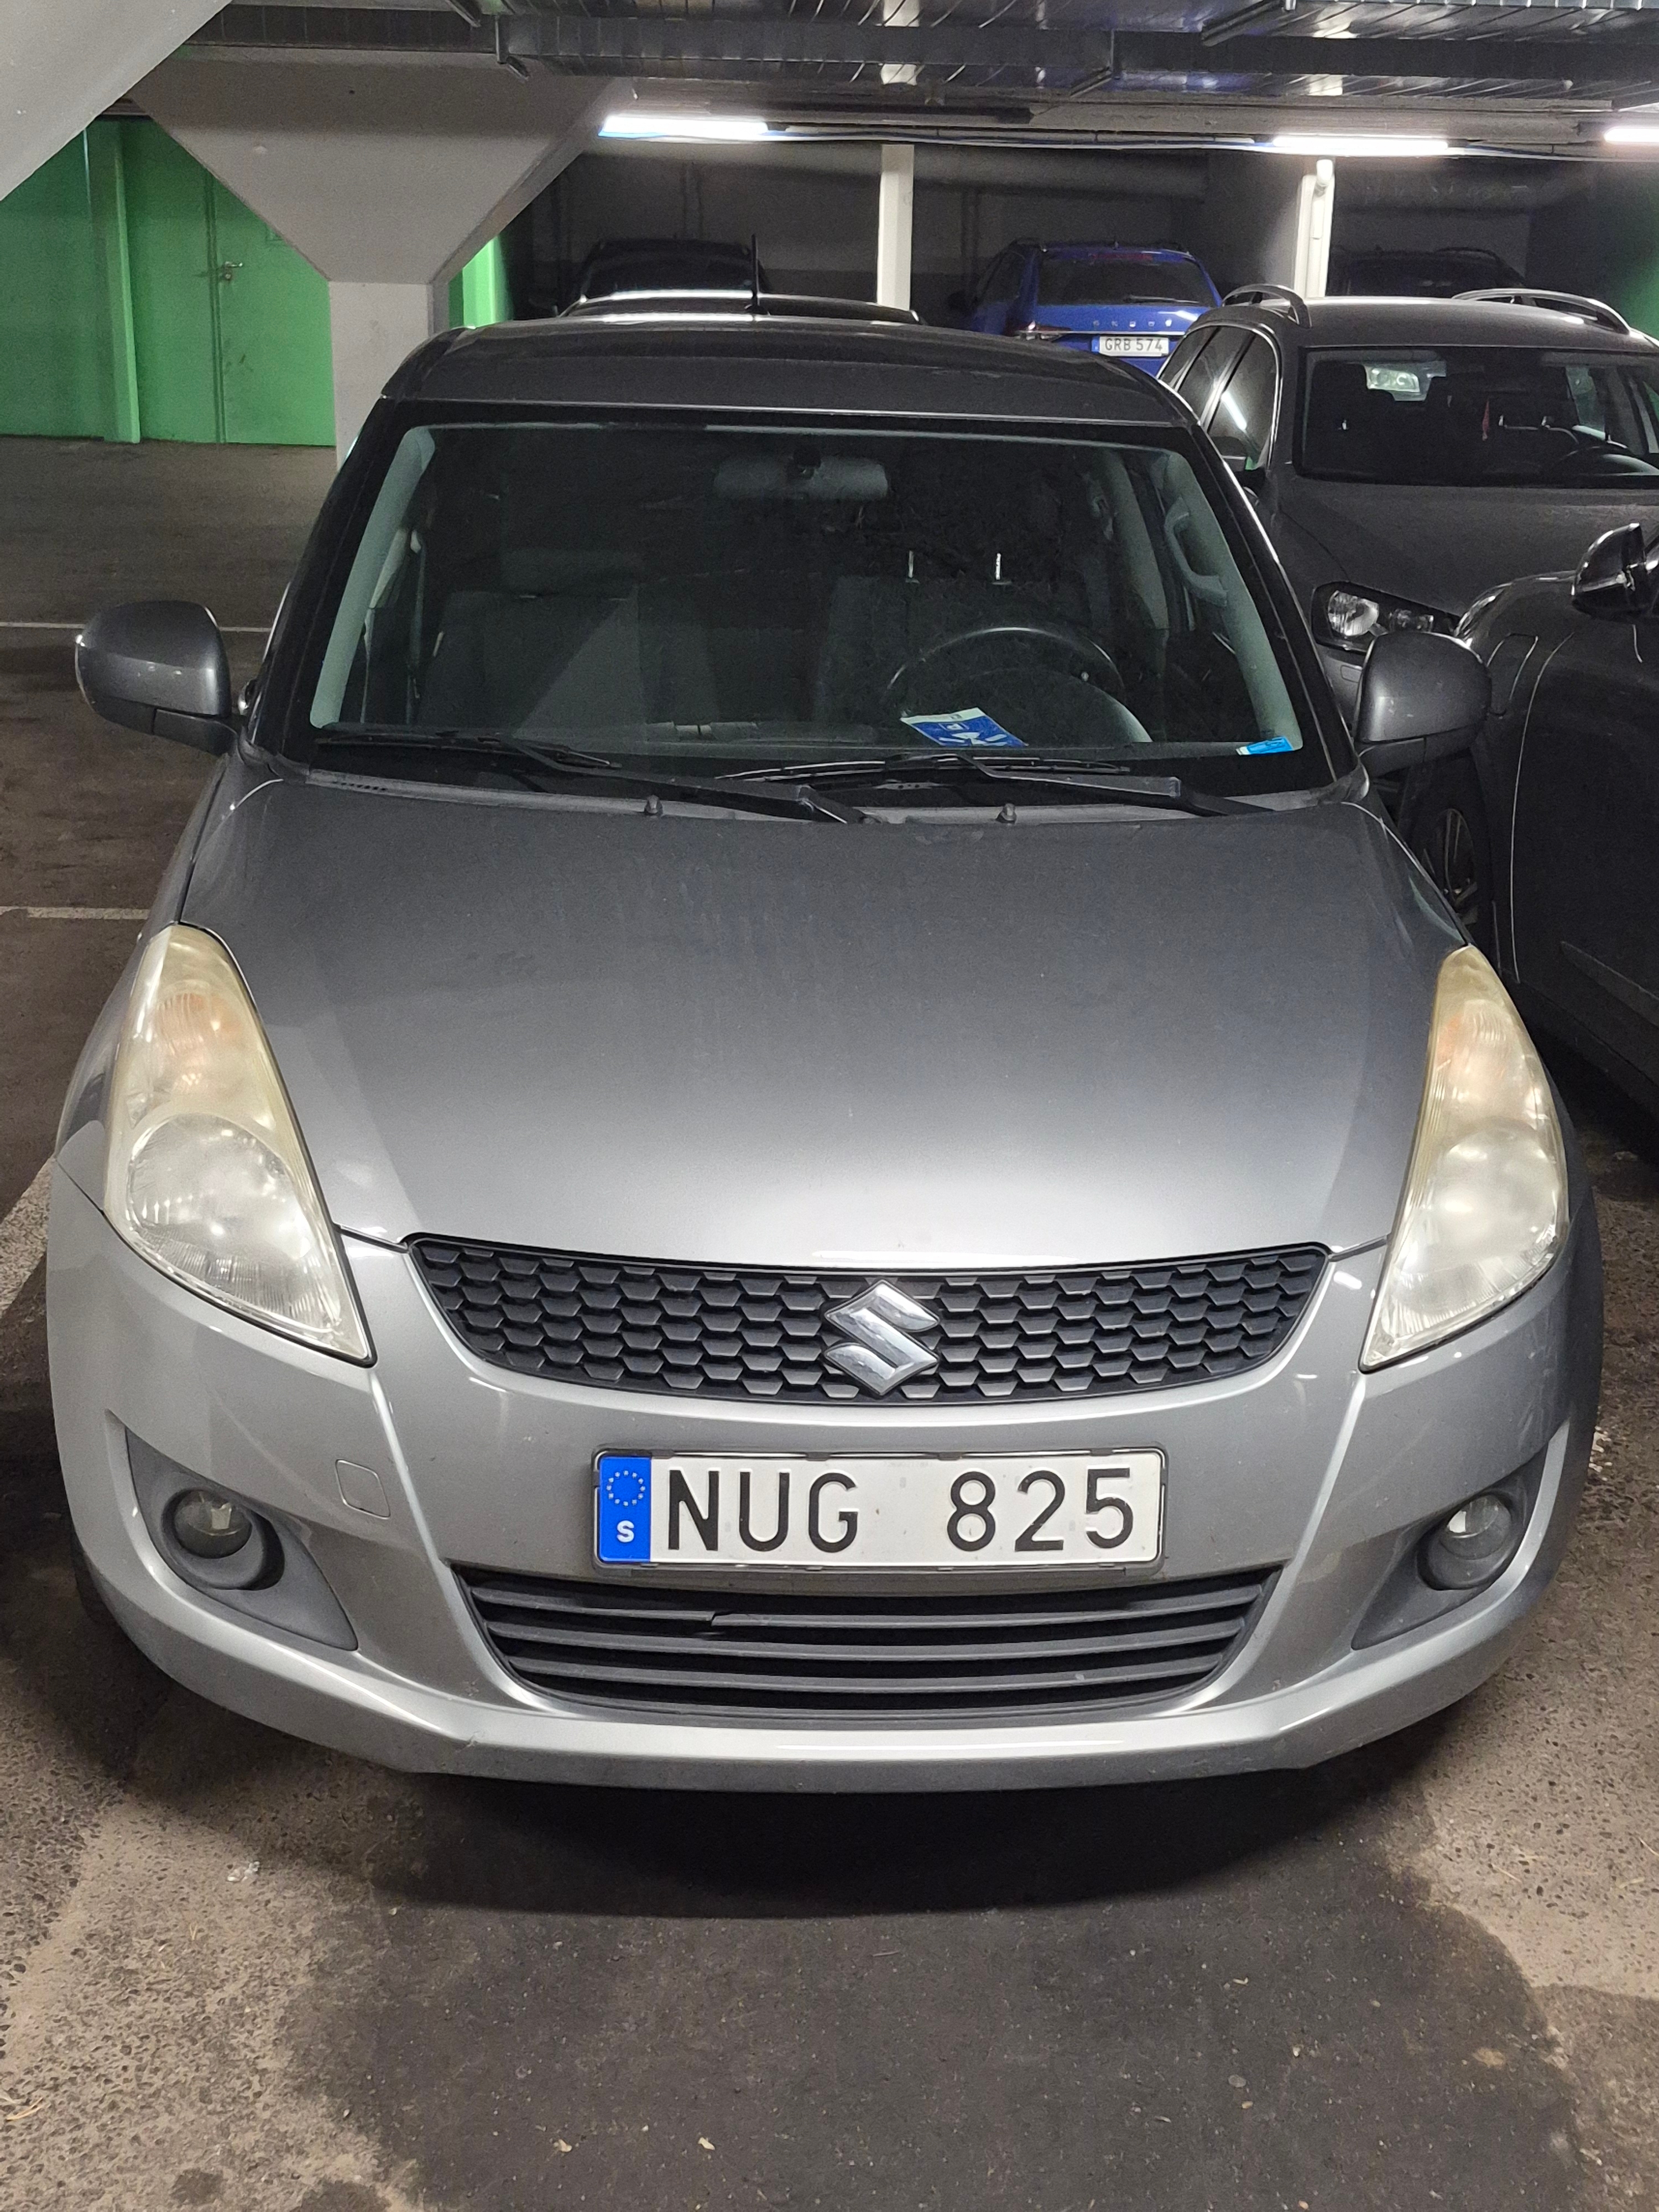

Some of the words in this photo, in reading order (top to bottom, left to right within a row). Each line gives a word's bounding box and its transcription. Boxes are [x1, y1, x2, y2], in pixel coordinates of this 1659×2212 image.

[1105, 338, 1131, 351] GRB
[1136, 338, 1163, 351] 574
[668, 1469, 859, 1553] NUG
[947, 1467, 1134, 1552] 825
[616, 1520, 635, 1543] S
